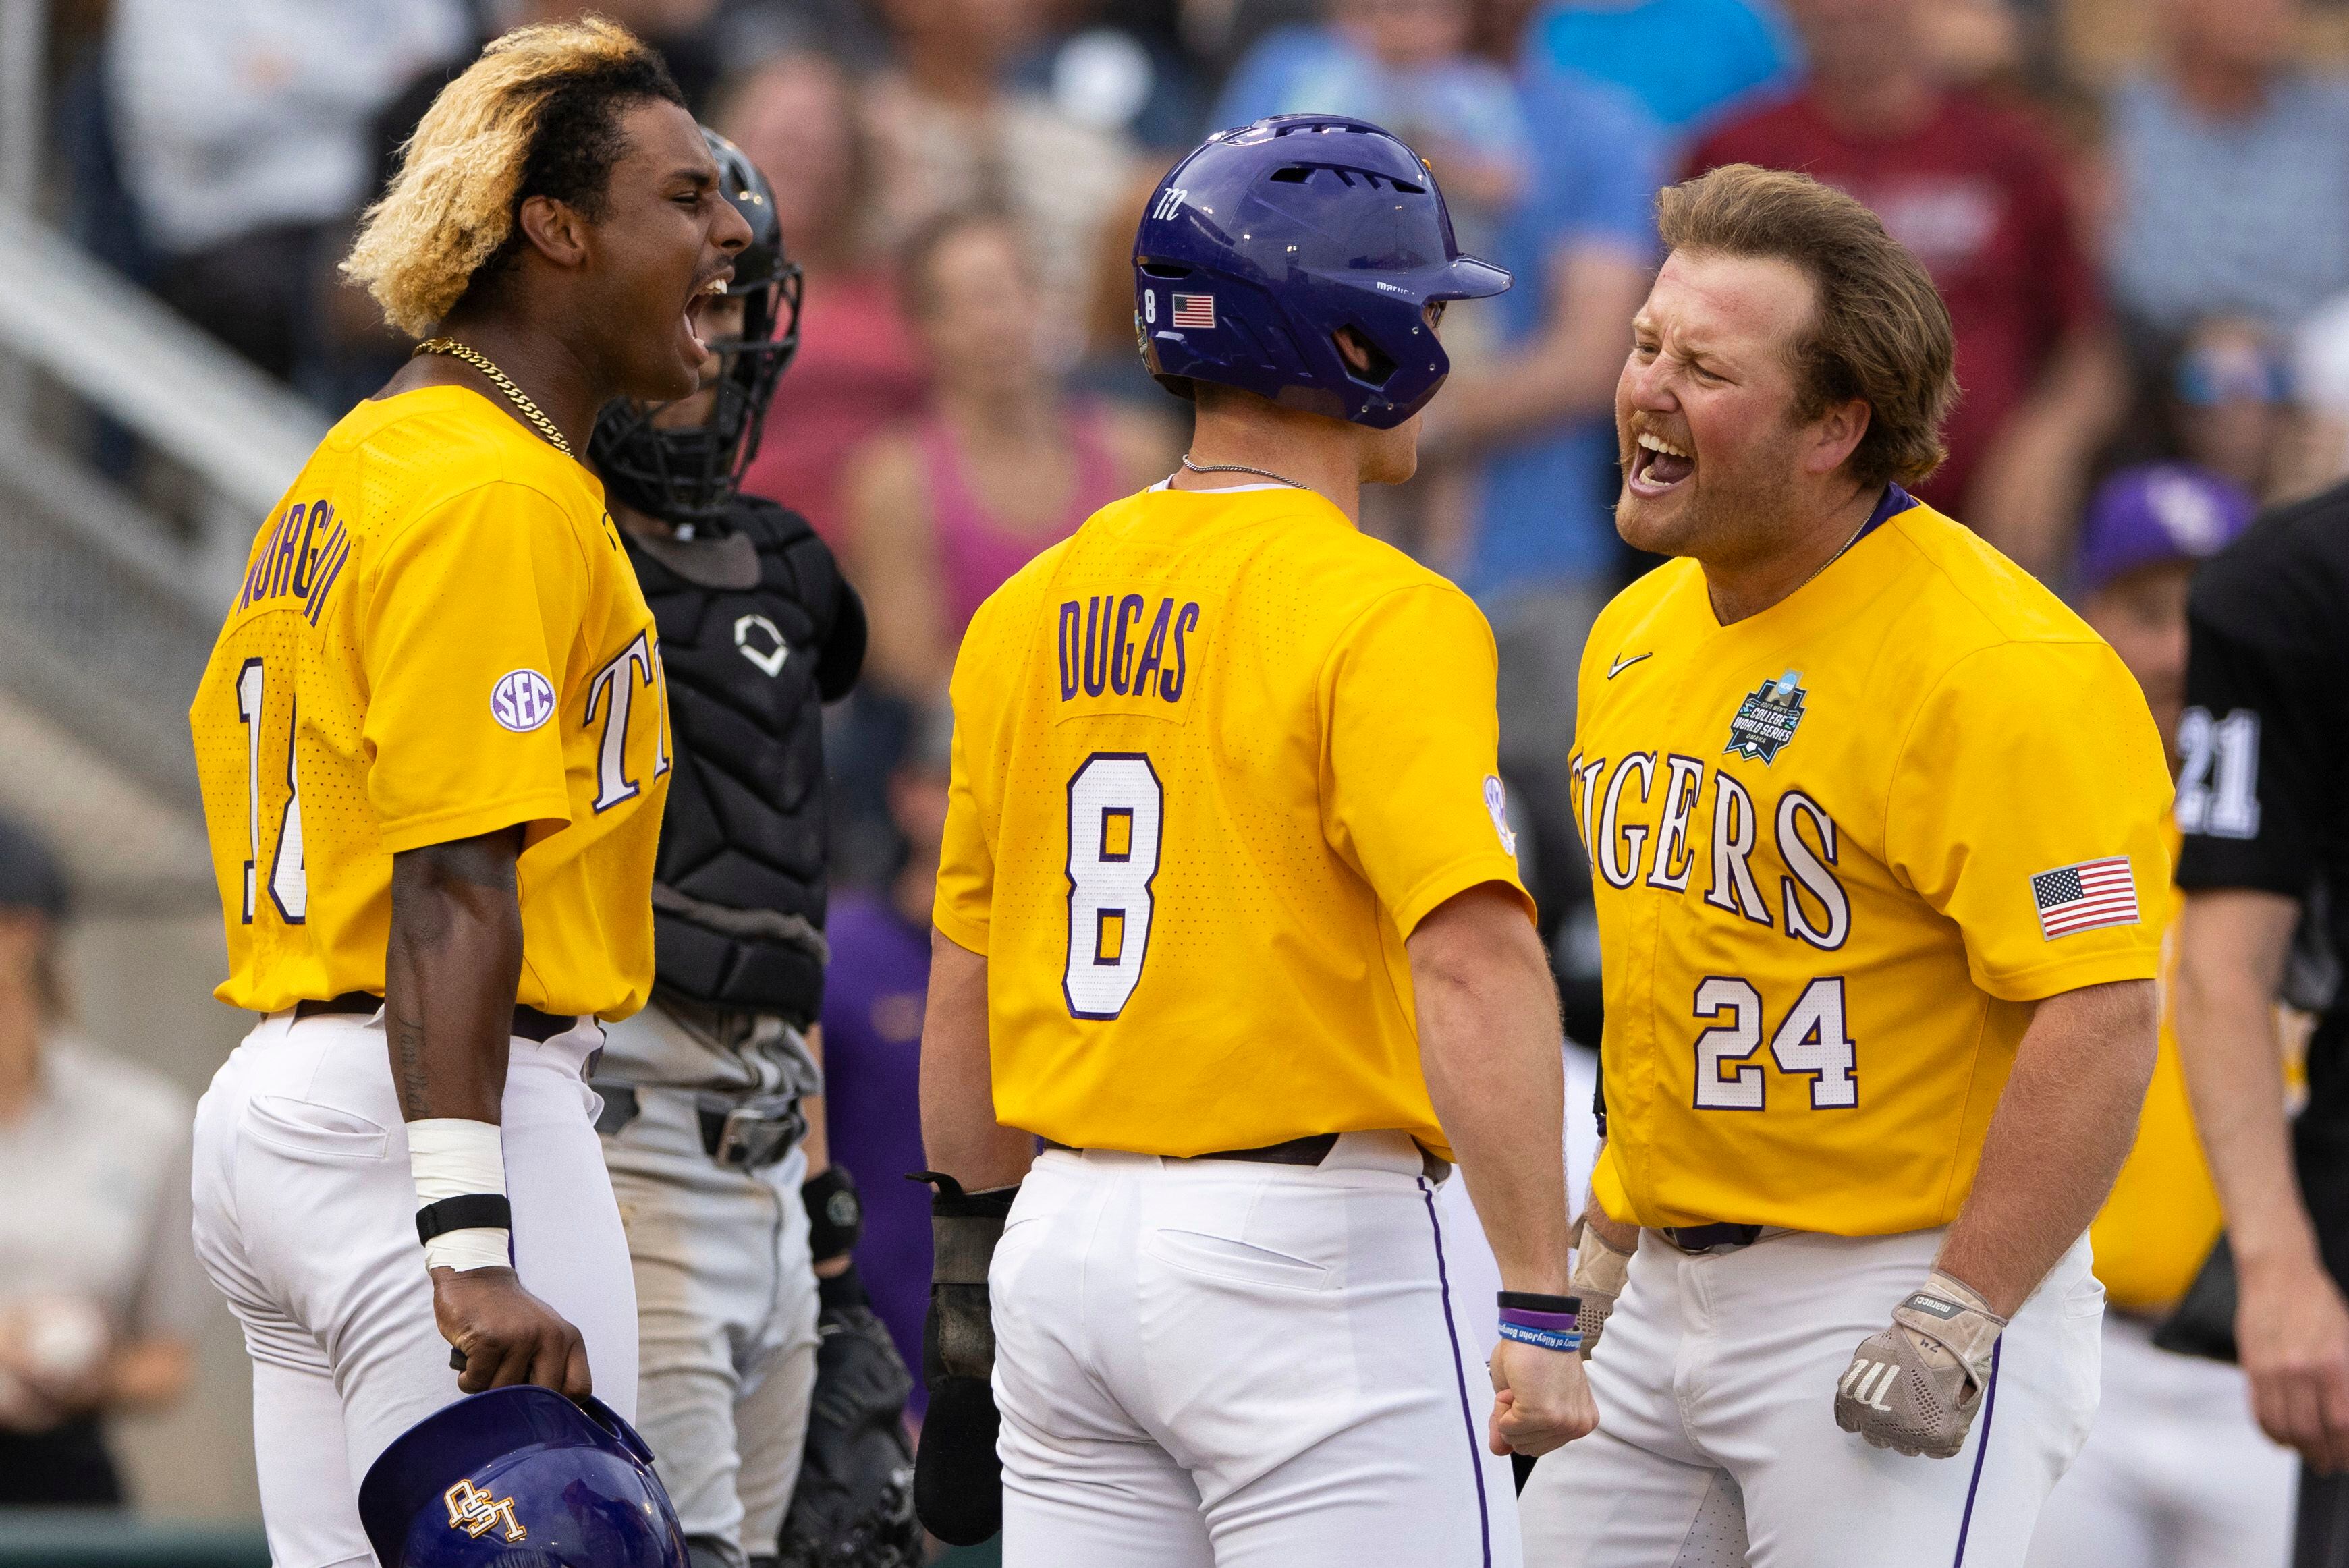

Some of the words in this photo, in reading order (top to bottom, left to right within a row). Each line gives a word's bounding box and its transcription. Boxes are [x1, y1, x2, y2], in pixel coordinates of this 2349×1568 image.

[1144, 289, 1156, 324] 8
[1059, 593, 1200, 703] DUGAS
[494, 671, 552, 729] SEC
[1750, 707, 1788, 726] COLLEGE
[1732, 717, 1763, 733] WORLD
[1759, 724, 1792, 742] SERIES
[1746, 733, 1767, 744] OMAHA
[2176, 704, 2261, 841] 21
[1061, 751, 1164, 1021] 8
[1692, 976, 1858, 1111] 24
[1913, 1295, 1951, 1313] marucci
